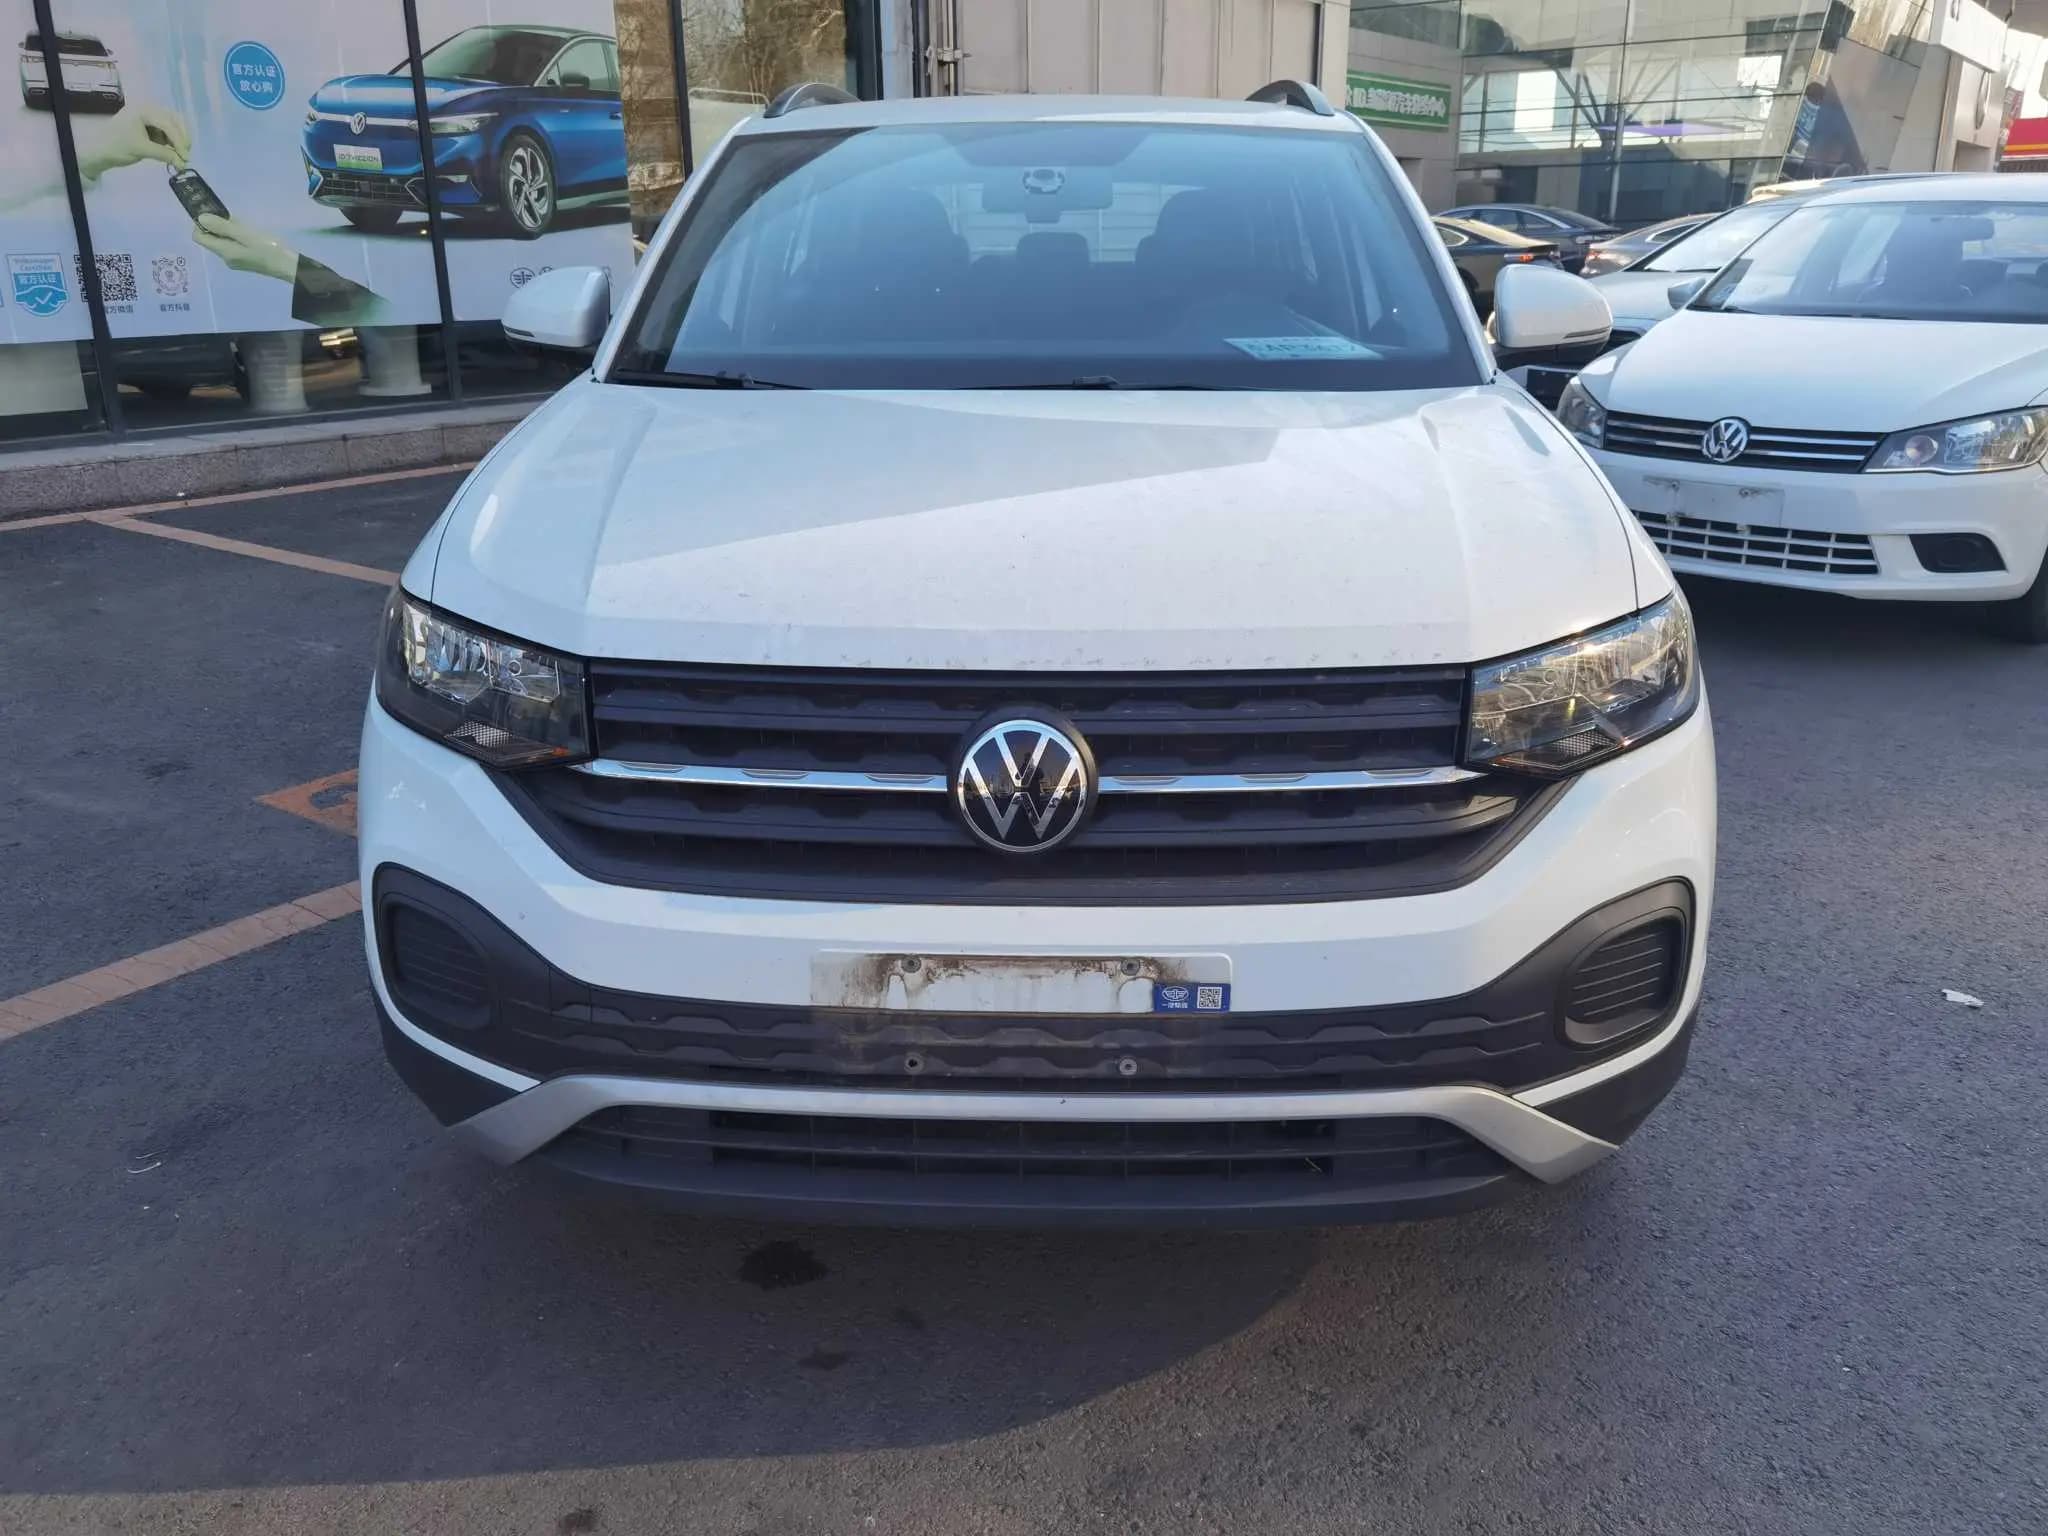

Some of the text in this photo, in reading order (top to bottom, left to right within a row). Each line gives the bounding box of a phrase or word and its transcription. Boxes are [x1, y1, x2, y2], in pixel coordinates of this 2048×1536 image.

[231, 63, 277, 78] 官方认证
[240, 80, 273, 93] 放心购
